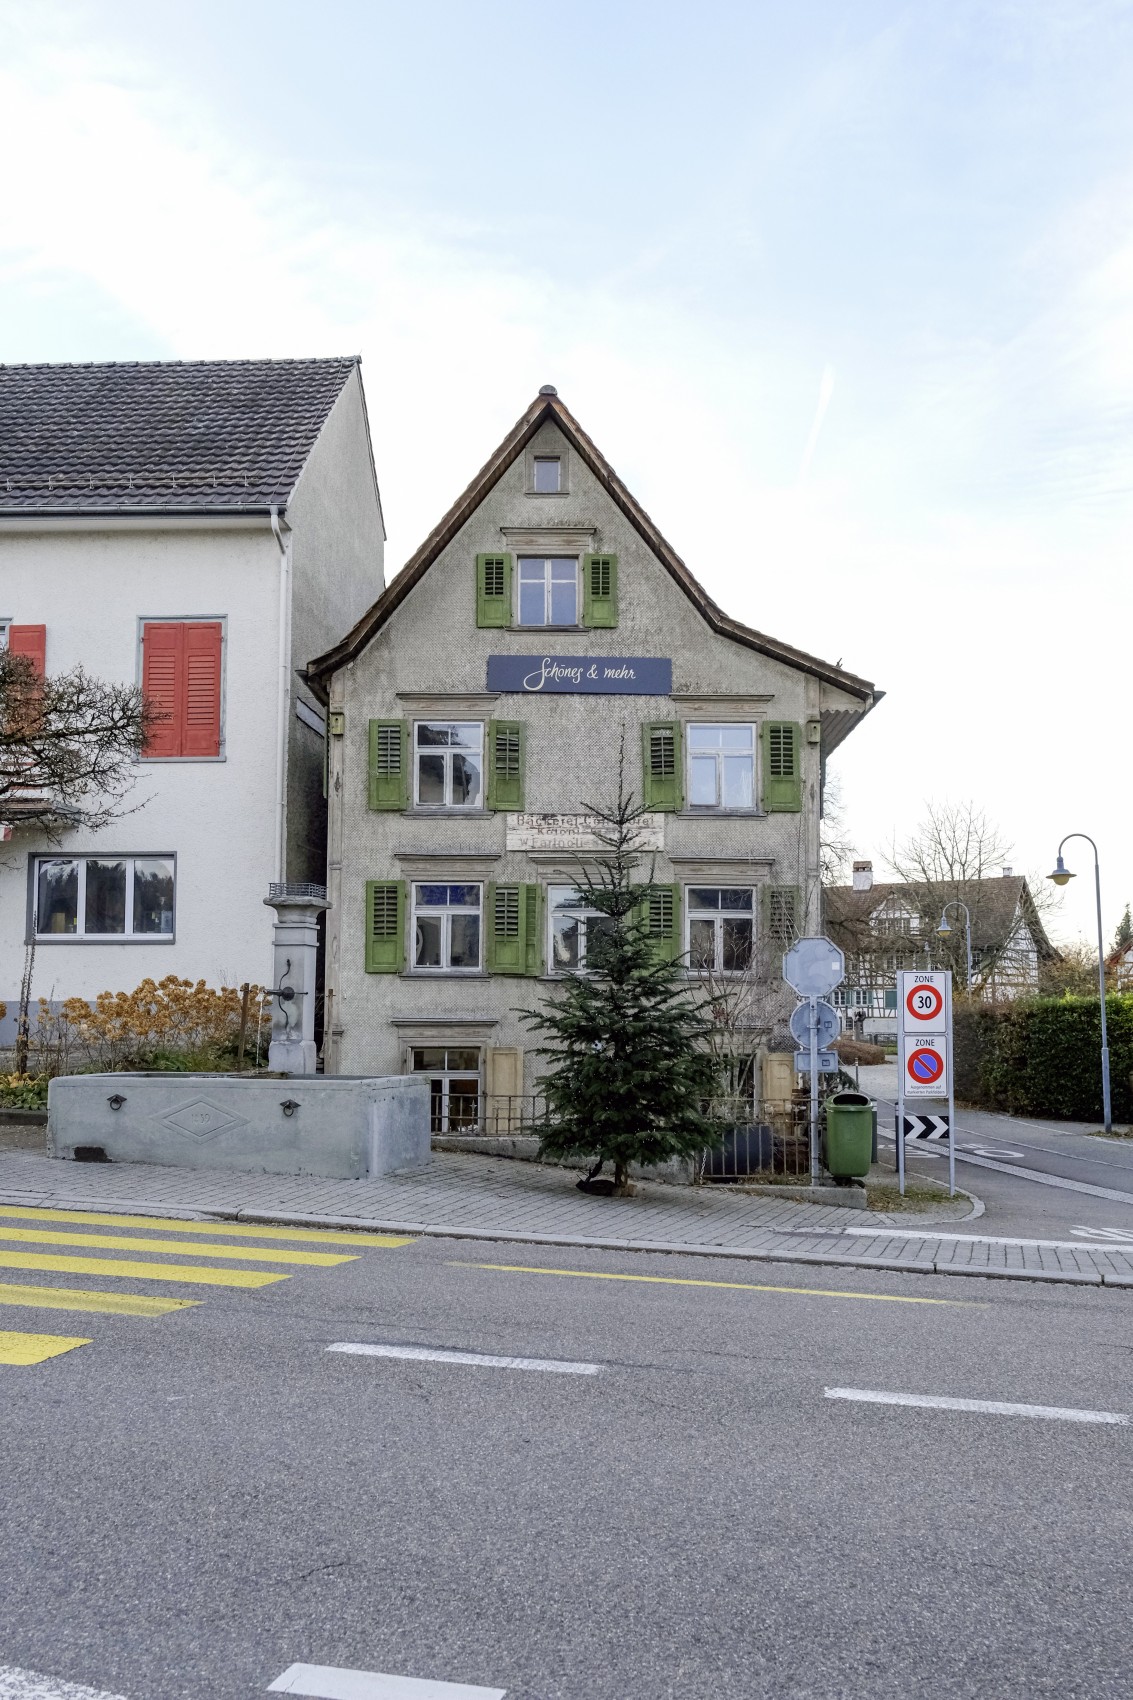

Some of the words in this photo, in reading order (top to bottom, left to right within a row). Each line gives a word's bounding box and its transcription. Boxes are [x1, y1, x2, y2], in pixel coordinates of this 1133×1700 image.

[587, 664, 599, 679] &
[603, 664, 636, 679] mehr
[914, 975, 934, 983] ZONE
[917, 995, 932, 1009] 30
[915, 1039, 935, 1047] ZONE
